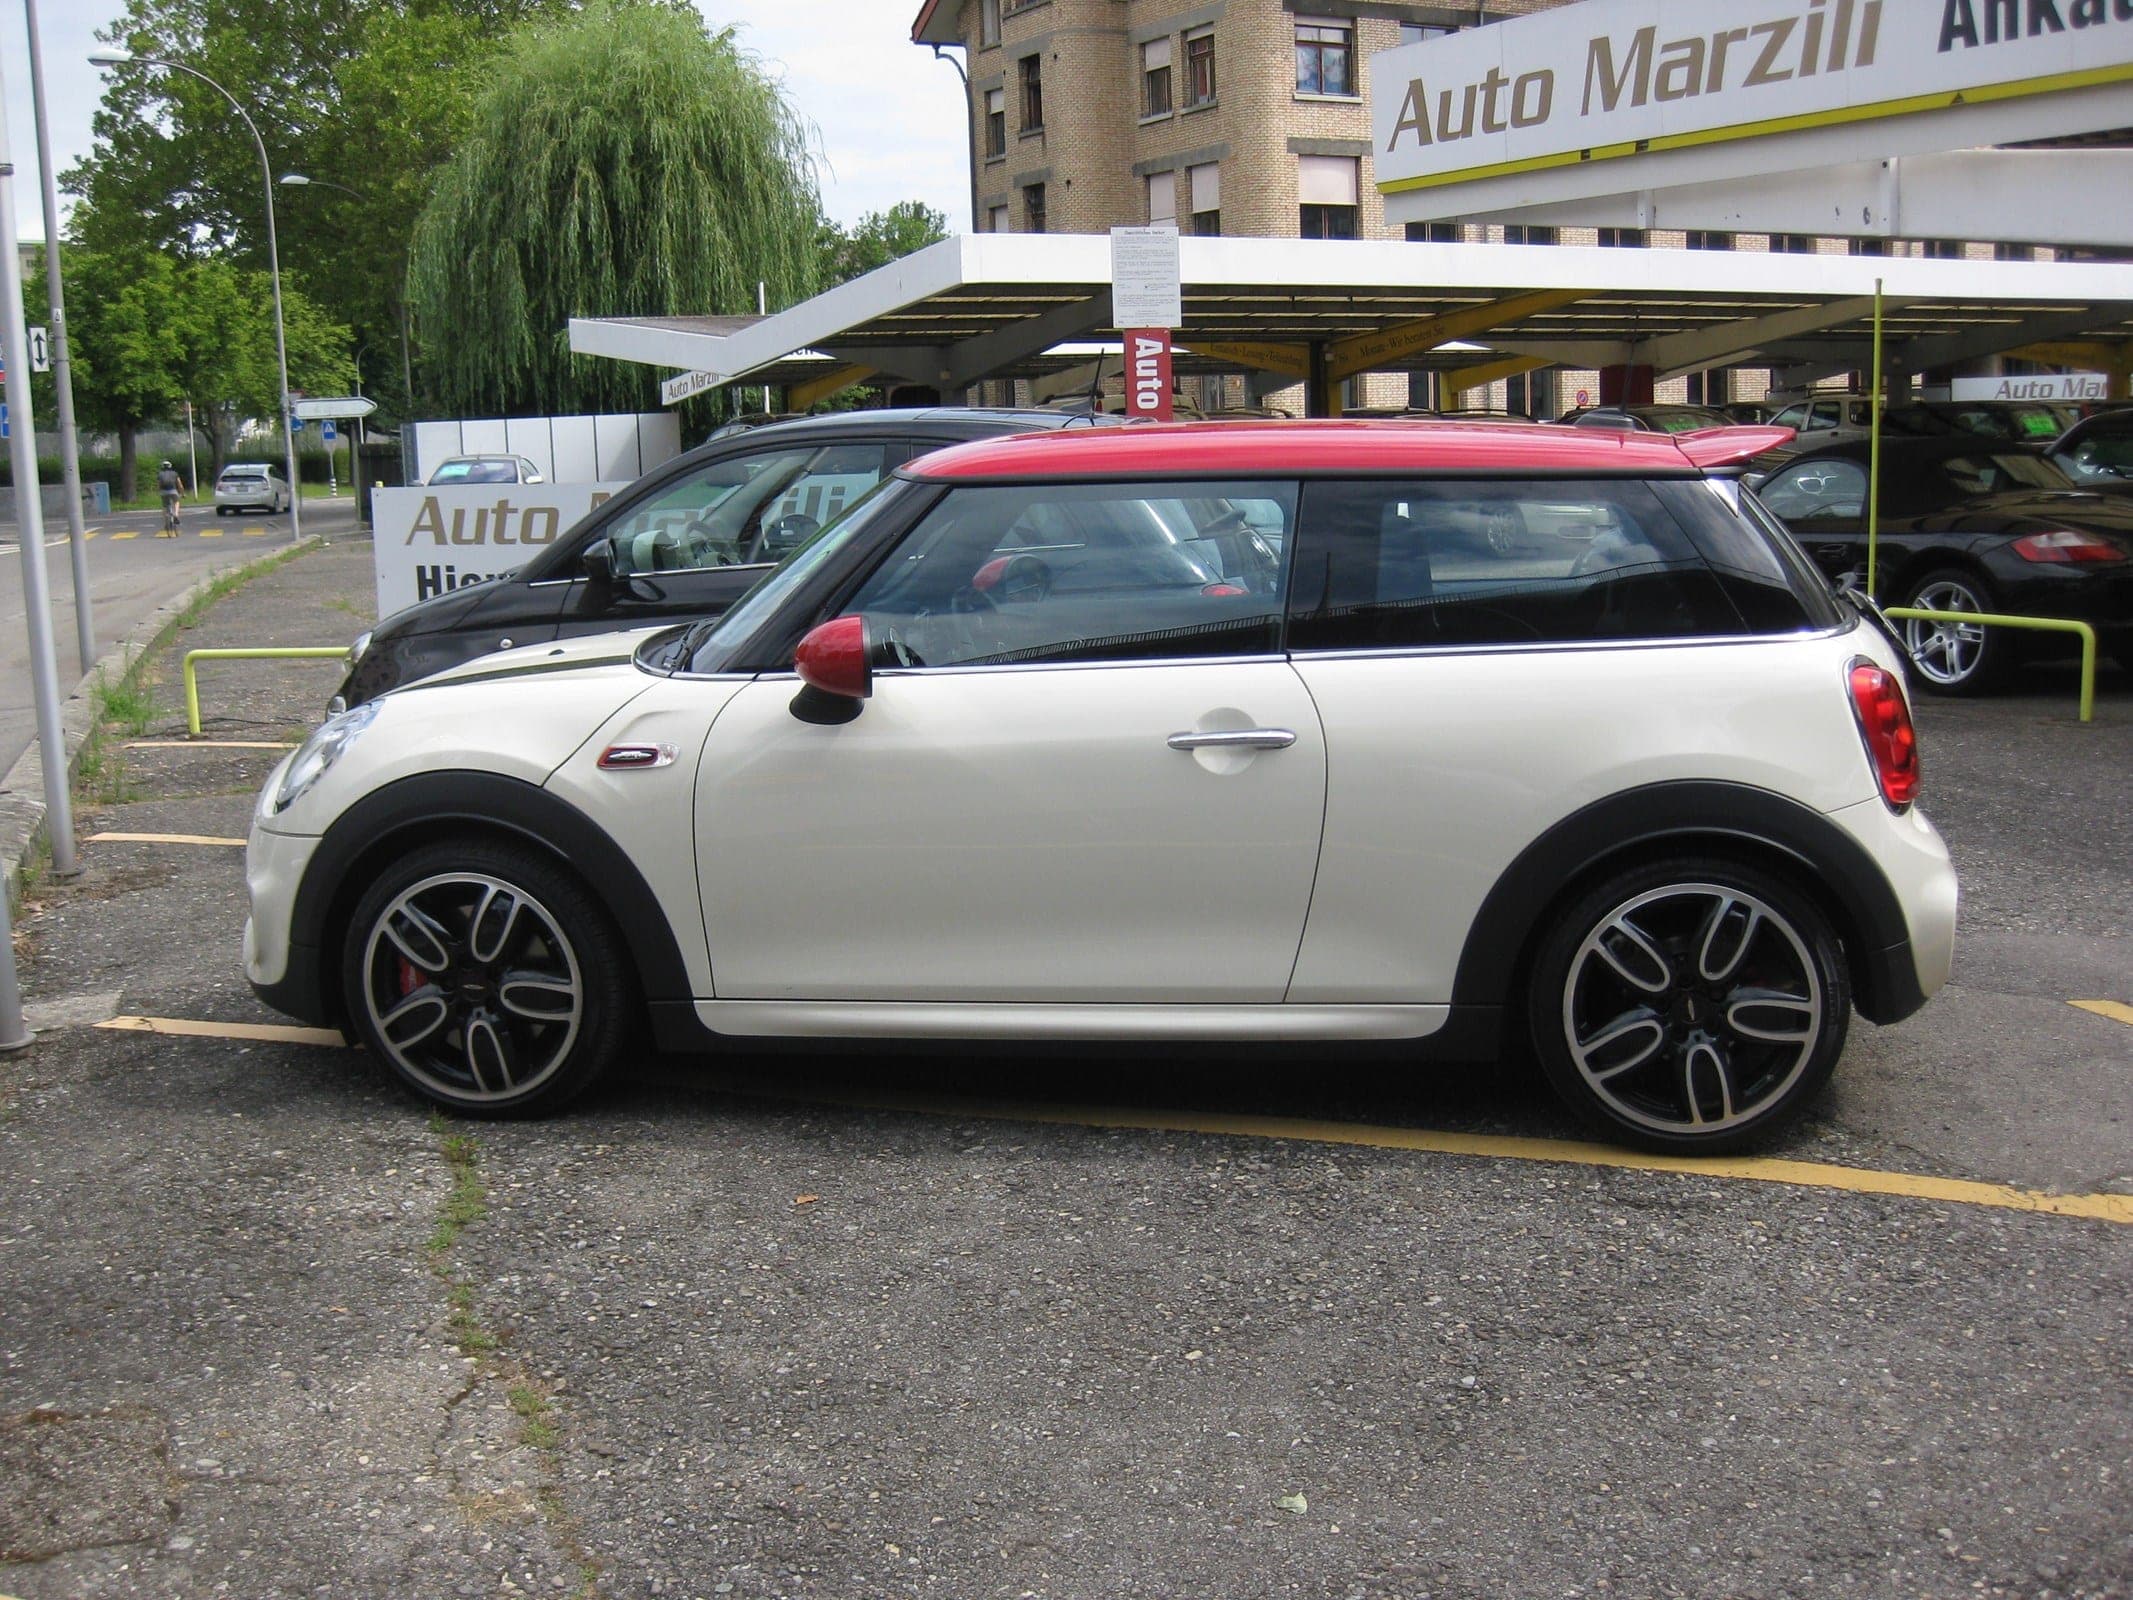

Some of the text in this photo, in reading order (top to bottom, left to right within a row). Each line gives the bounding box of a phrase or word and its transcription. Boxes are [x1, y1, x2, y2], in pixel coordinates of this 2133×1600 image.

[1937, 0, 2133, 53] Anka
[1387, 0, 1883, 152] Auto Marzili
[668, 381, 689, 399] Auto
[1135, 337, 1164, 410] Auto
[1994, 380, 2054, 399] Auto
[404, 496, 560, 546] Auto
[416, 565, 506, 601] Hi
